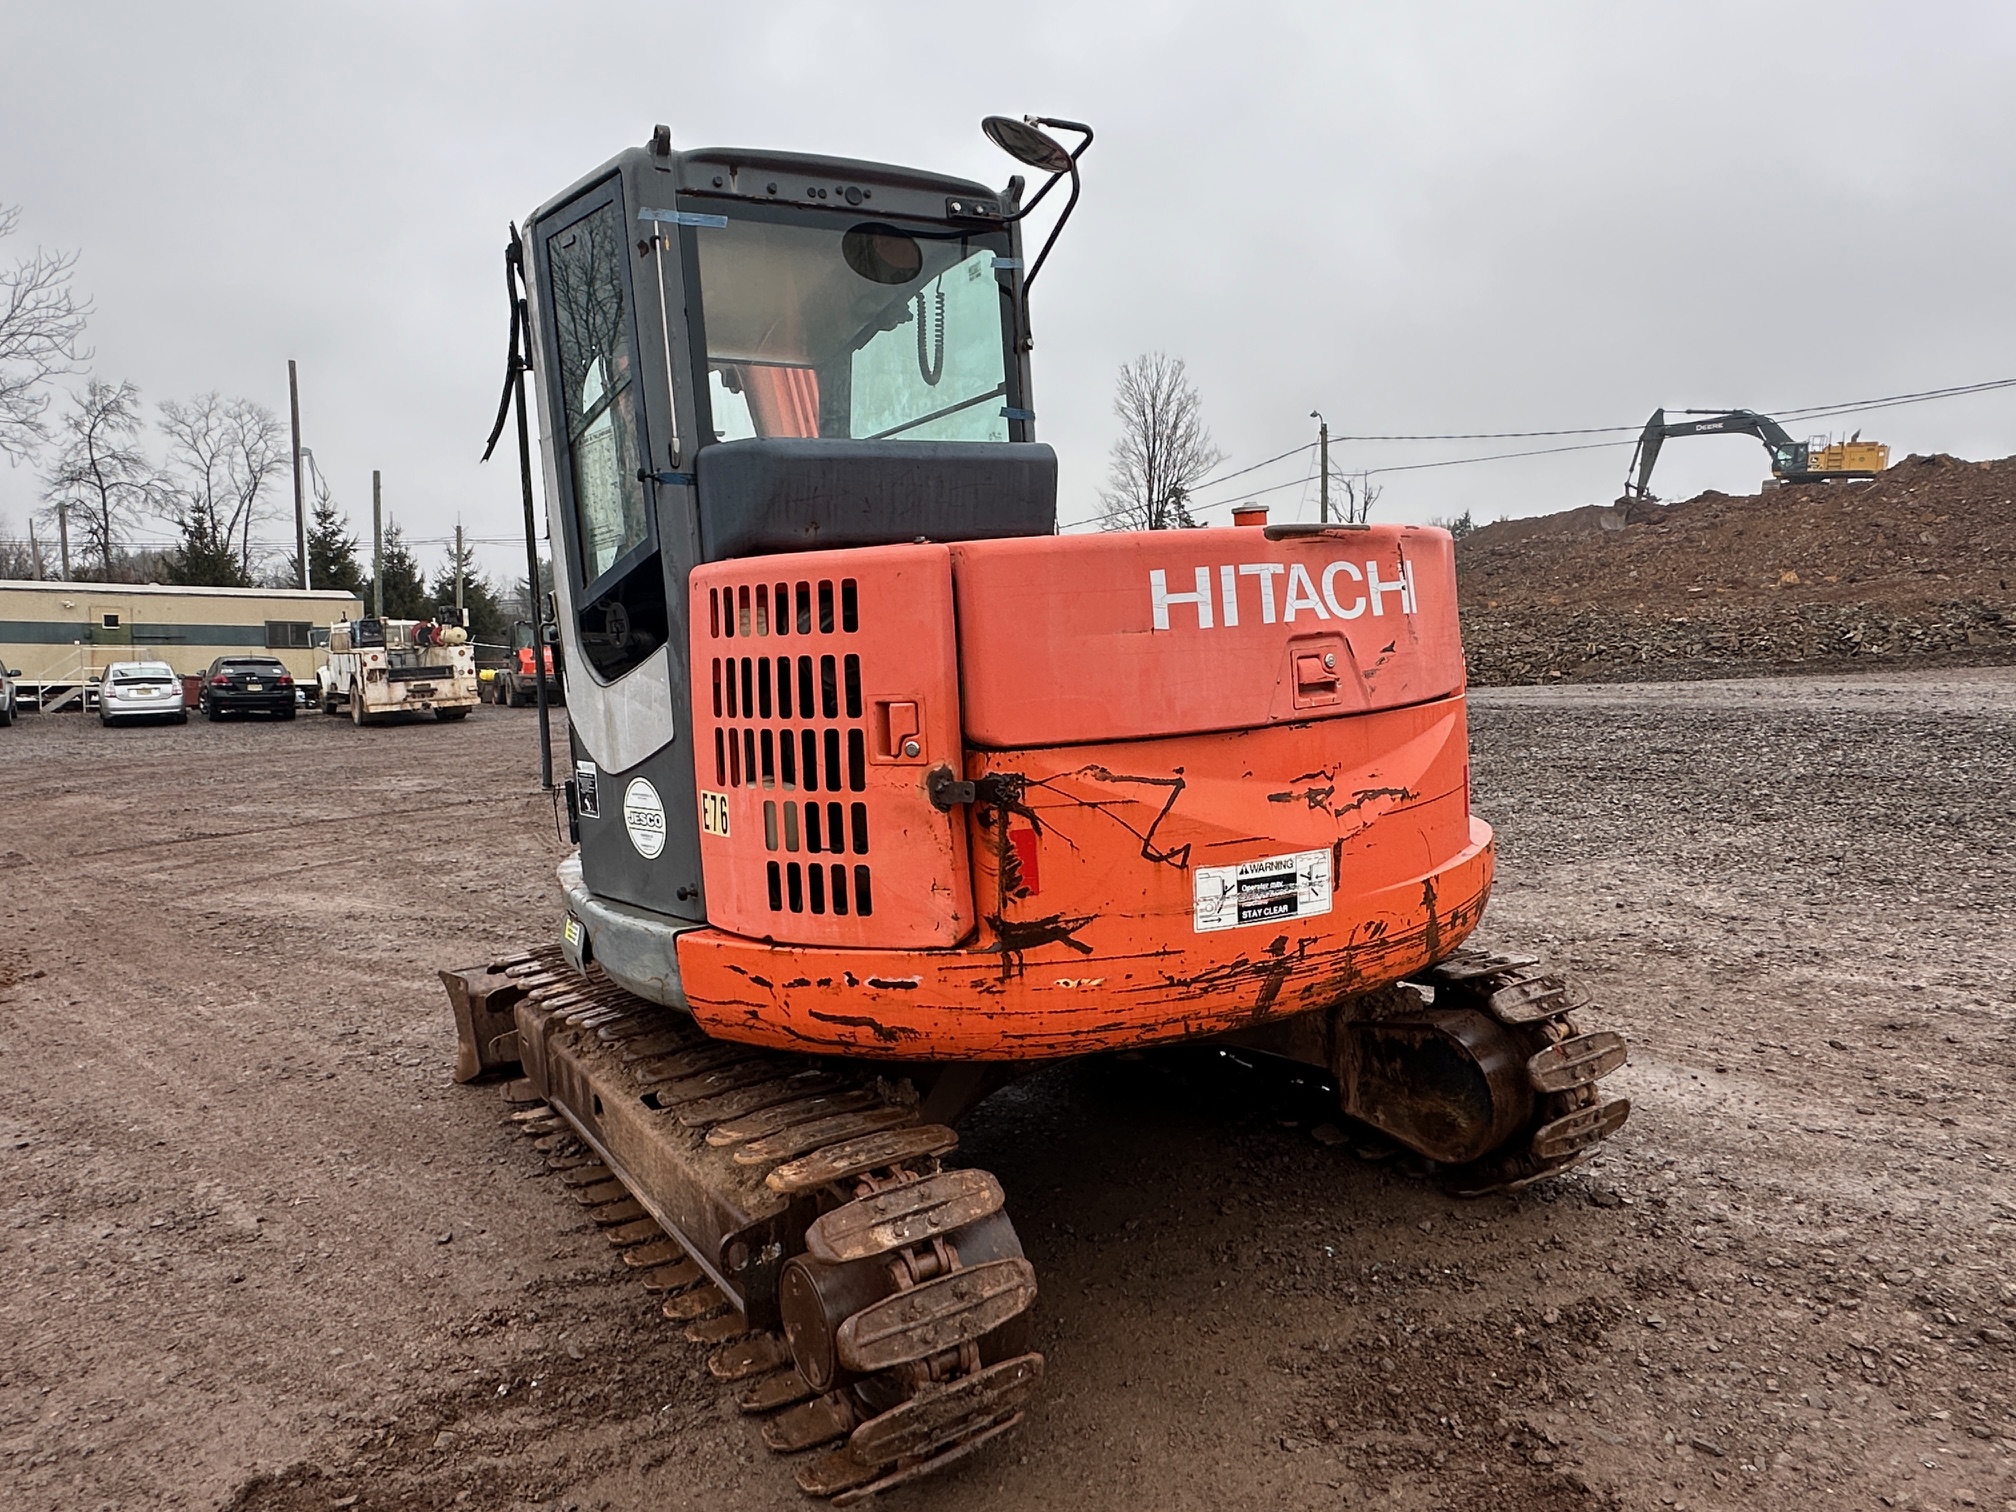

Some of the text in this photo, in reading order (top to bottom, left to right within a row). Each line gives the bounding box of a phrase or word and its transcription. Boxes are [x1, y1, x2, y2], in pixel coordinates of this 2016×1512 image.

[1695, 422, 1724, 431] DEERE
[1150, 560, 1418, 630] HITACHI
[627, 810, 664, 829] JESCO
[702, 792, 728, 835] E76
[1249, 858, 1294, 873] WARNING
[1241, 904, 1289, 919] STAY CLEAR
